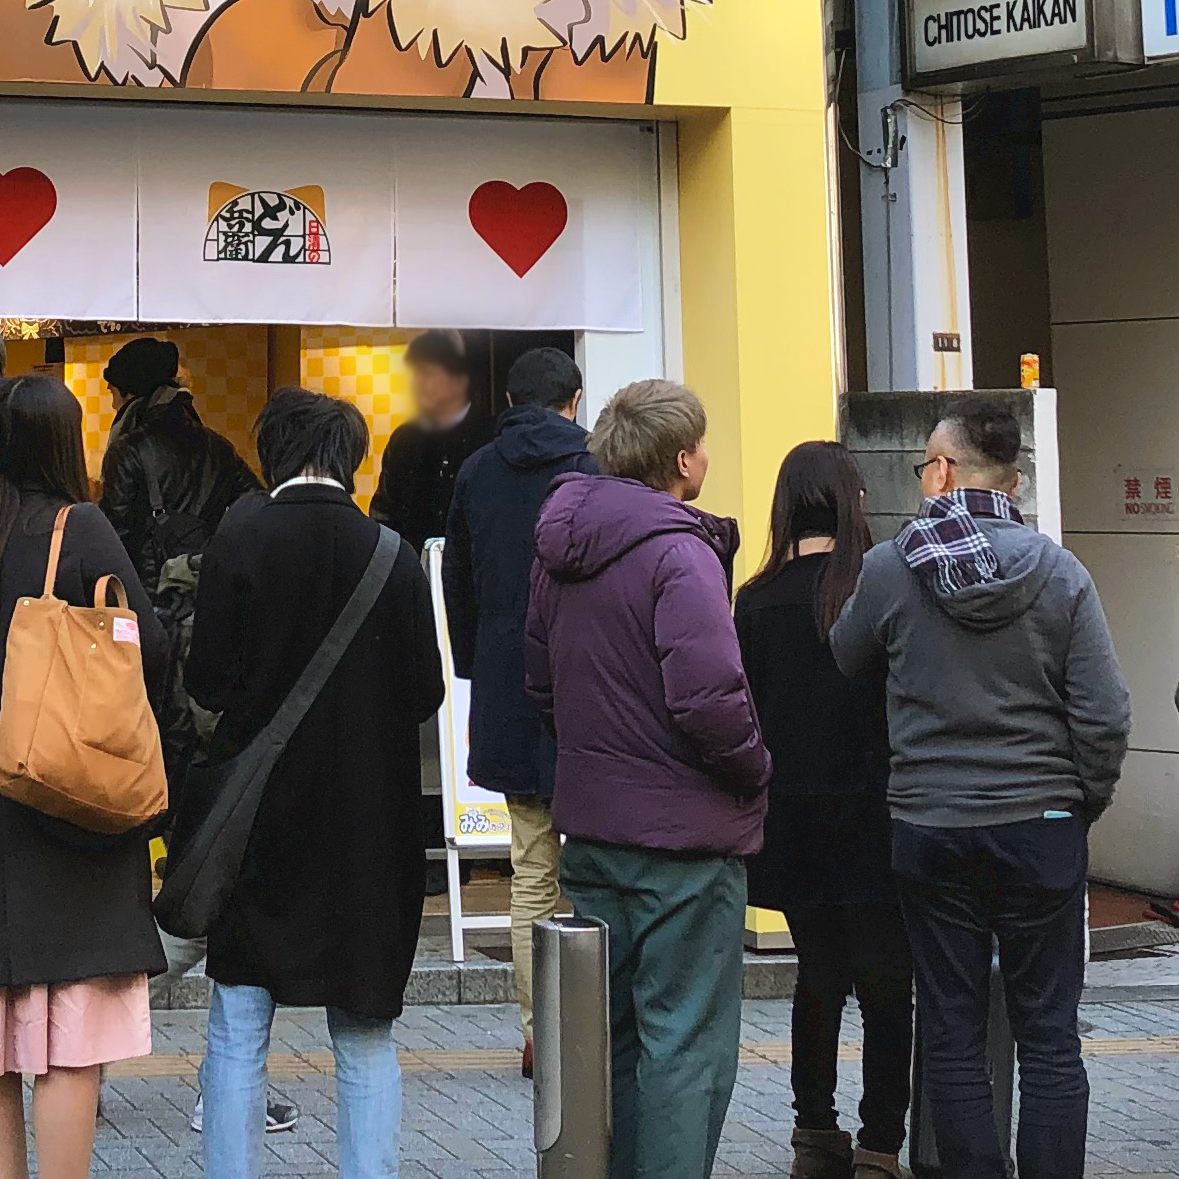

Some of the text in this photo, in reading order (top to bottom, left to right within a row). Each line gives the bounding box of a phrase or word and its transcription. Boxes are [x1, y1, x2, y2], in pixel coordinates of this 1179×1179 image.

[923, 3, 1002, 47] CHITOSE
[1125, 502, 1140, 515] NO
[459, 813, 490, 834] みみ
